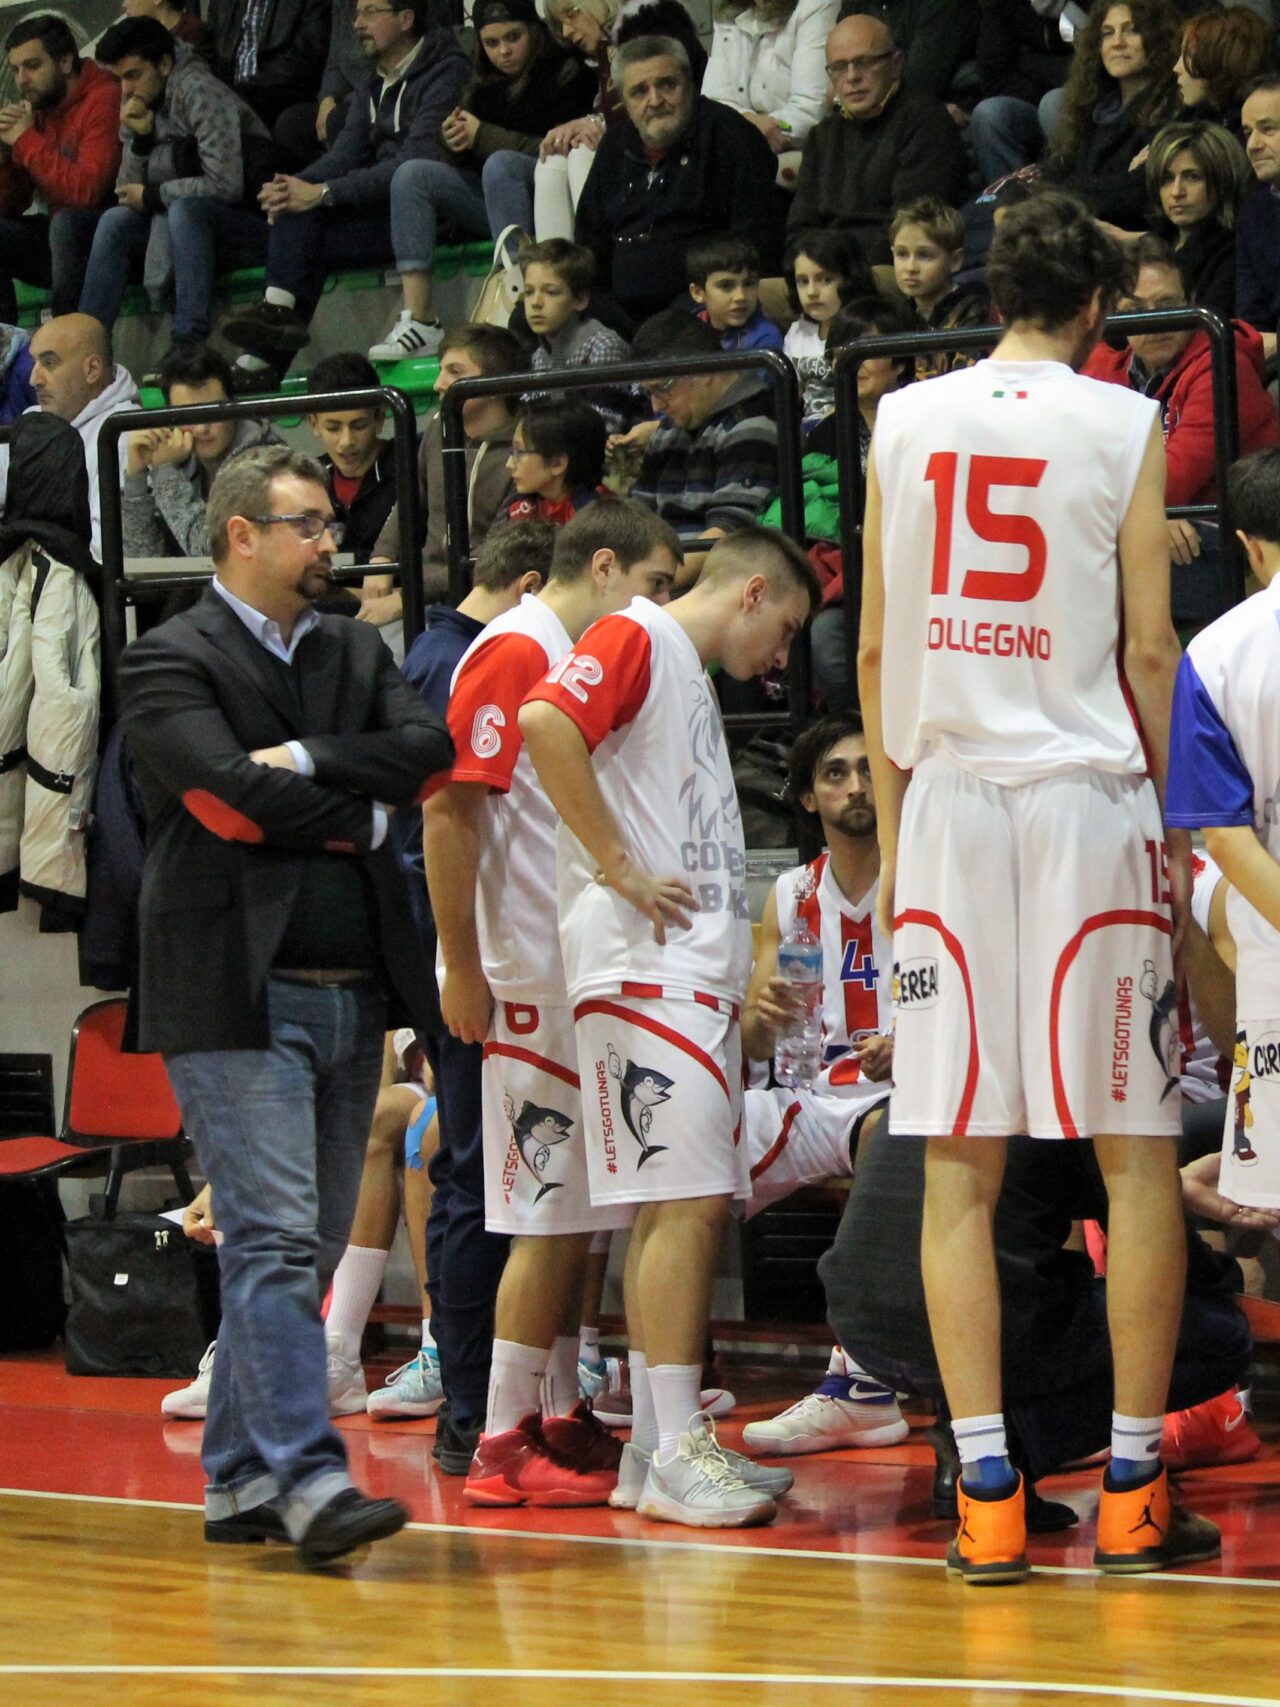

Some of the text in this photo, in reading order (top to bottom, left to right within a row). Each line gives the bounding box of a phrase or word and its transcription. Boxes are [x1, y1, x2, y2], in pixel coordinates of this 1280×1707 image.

[924, 451, 1048, 602] 15
[927, 617, 1051, 661] OLLEGNO
[546, 653, 604, 705] 12
[470, 704, 506, 759] 6
[840, 939, 879, 991] 4
[1111, 976, 1133, 1103] #LETSGOTUNAS
[595, 1060, 618, 1175] #LETSGOTUNAS
